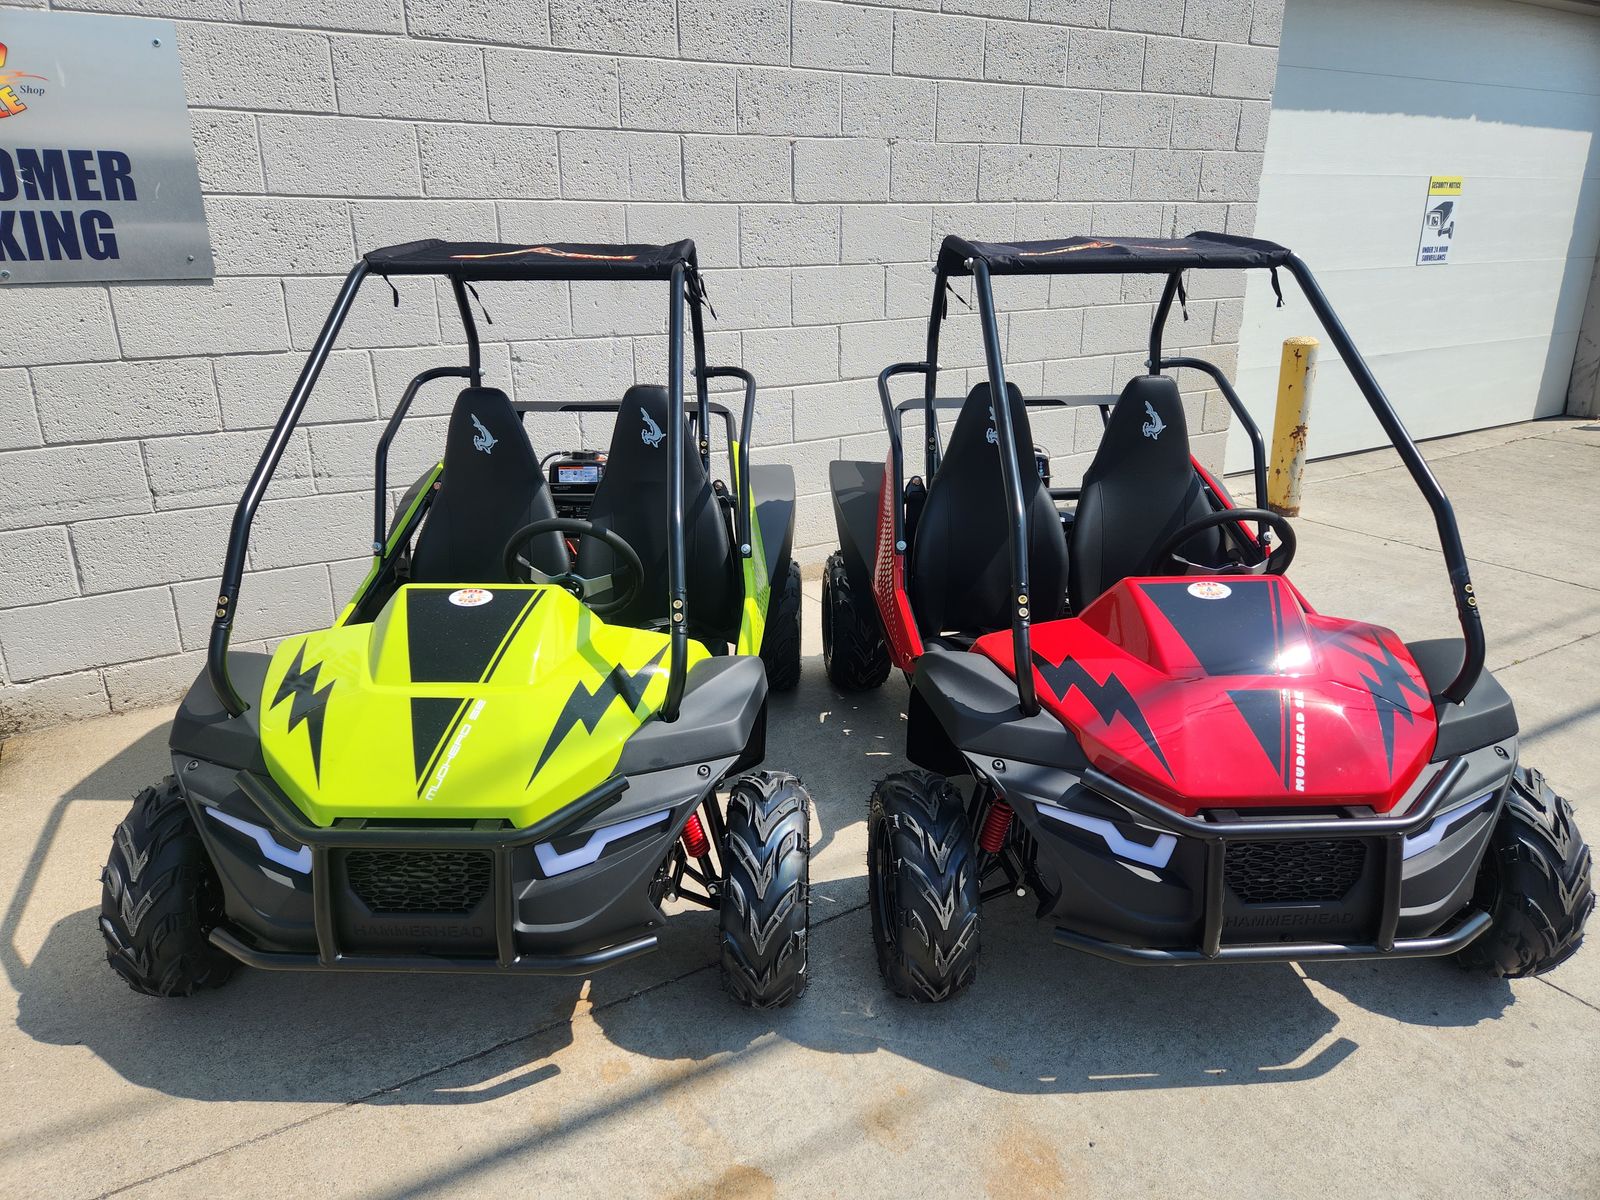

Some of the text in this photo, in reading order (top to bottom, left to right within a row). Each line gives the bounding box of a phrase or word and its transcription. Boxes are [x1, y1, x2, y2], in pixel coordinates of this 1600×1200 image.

[20, 85, 45, 96] Shop
[1295, 711, 1306, 792] MUDHEAD
[425, 724, 472, 800] MUDHEAD
[1224, 912, 1354, 928] HAMMERHEAD
[353, 925, 484, 938] HAMMERHEAD
